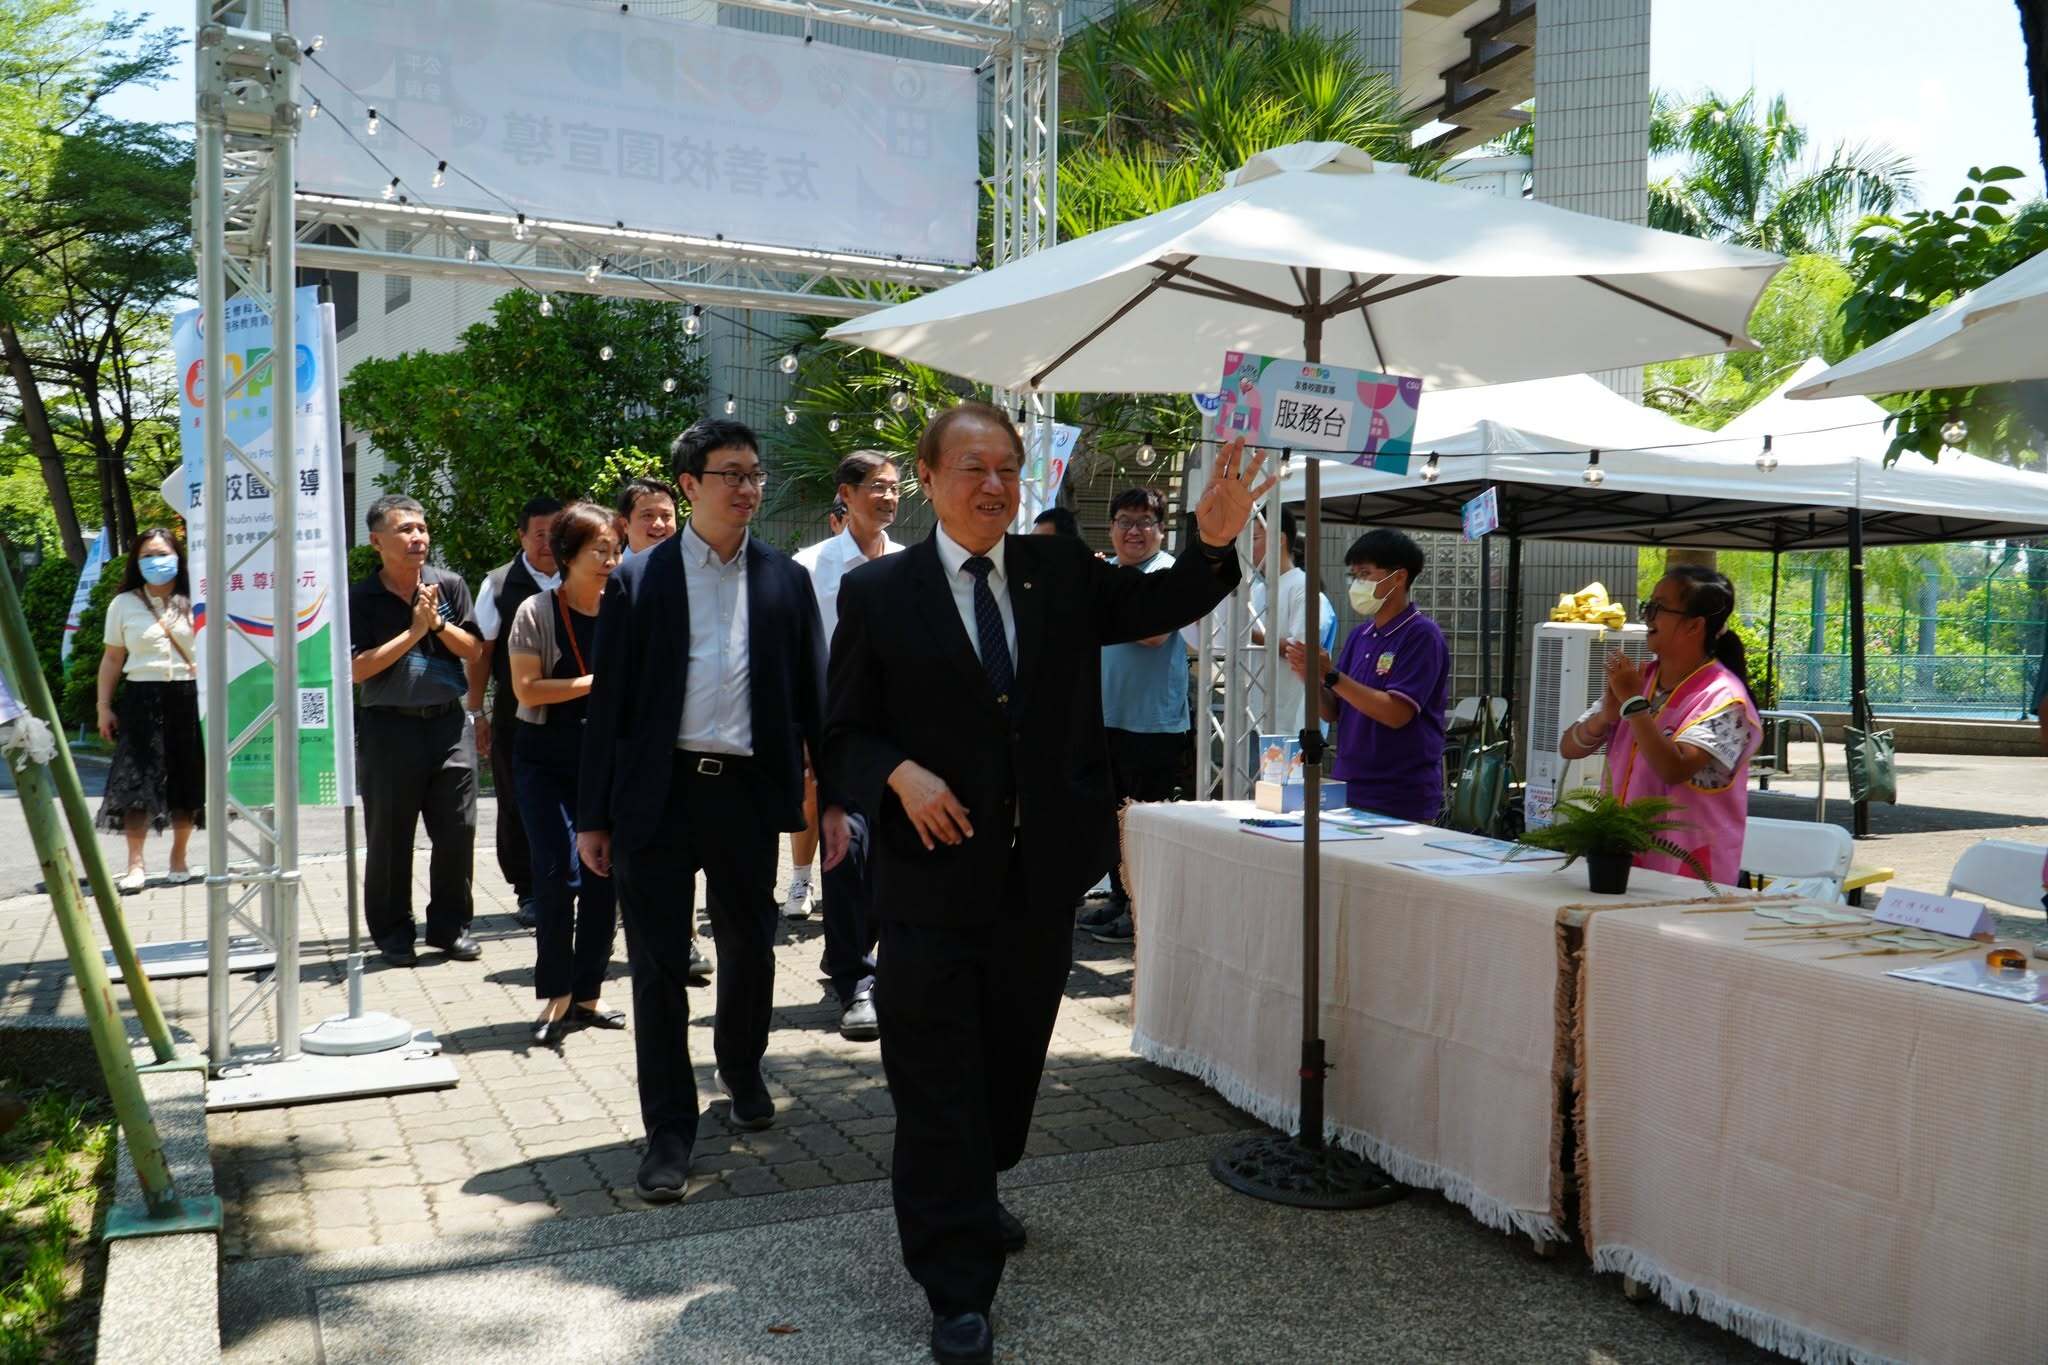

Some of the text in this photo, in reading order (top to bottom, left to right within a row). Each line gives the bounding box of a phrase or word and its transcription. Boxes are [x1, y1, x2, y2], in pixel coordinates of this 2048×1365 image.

[1273, 399, 1347, 438] 服務台
[189, 469, 320, 509] 友校園導
